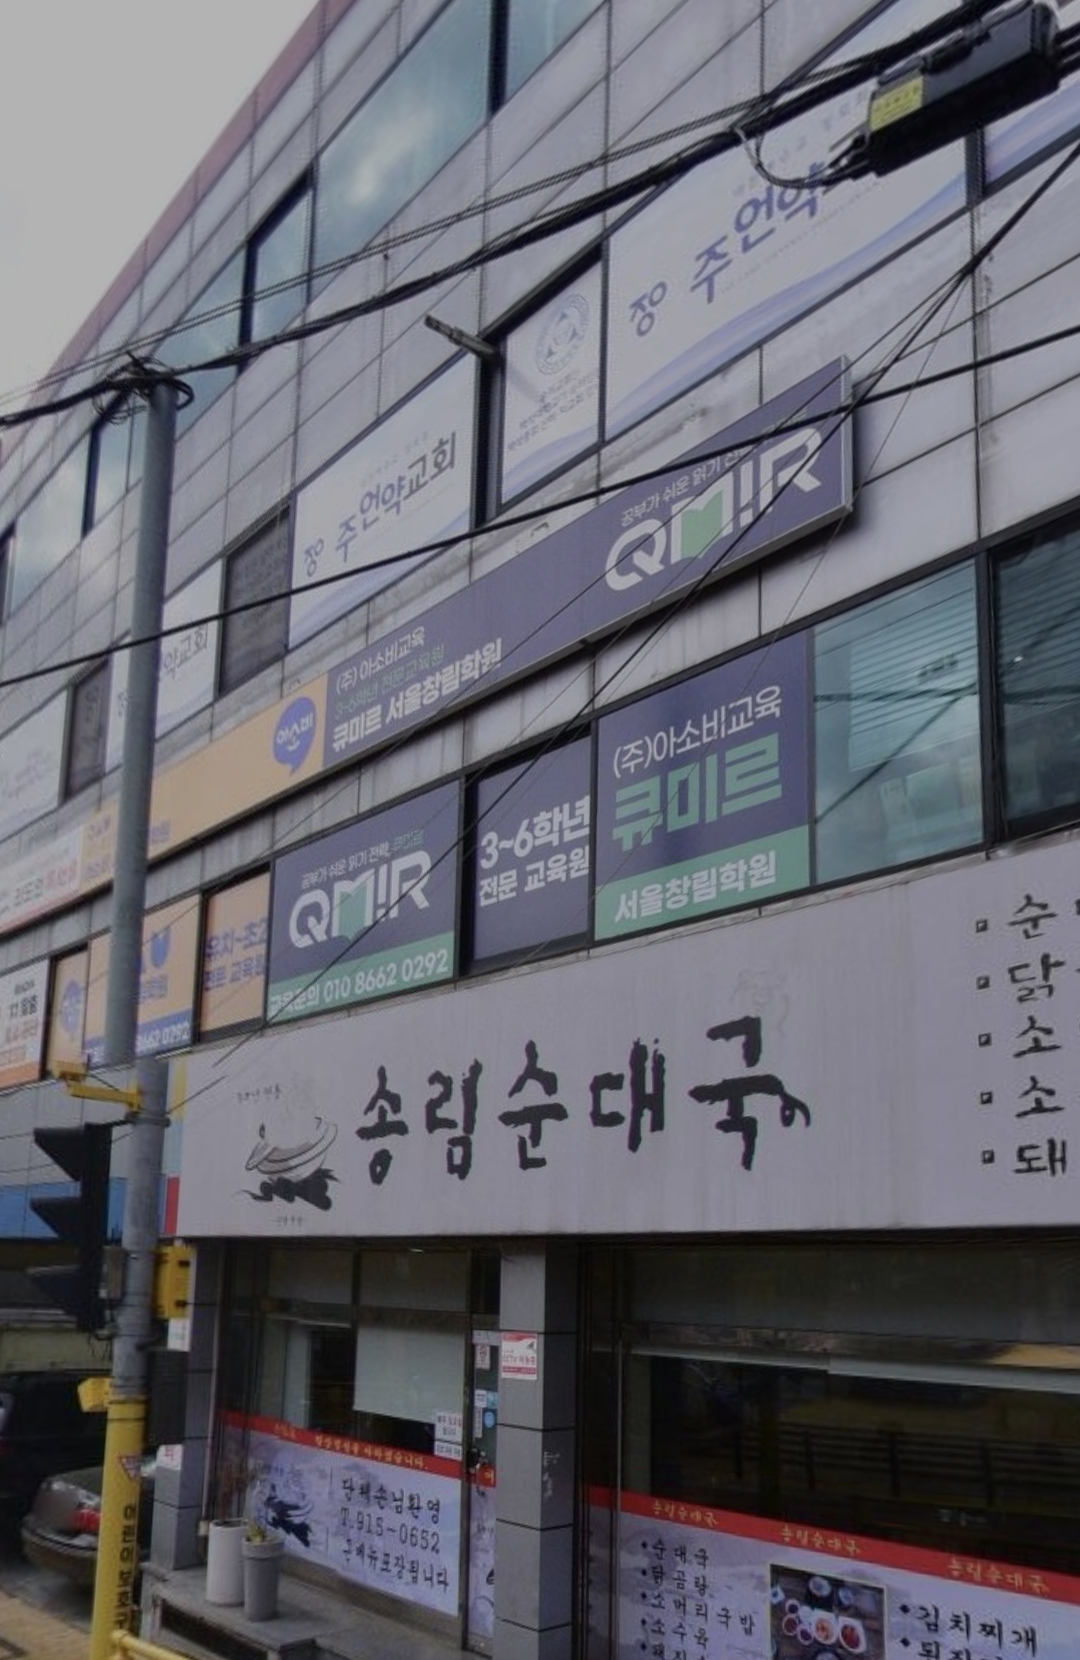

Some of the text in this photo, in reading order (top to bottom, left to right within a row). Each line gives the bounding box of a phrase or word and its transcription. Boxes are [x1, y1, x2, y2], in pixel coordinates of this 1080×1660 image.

[332, 637, 502, 752] 큐미르 서울창림학원
[613, 684, 782, 778] (주)아소비교육
[611, 731, 783, 853] 큐미르
[479, 794, 591, 869] 3~6학년
[478, 844, 591, 908] 전문 교육원
[614, 850, 777, 923] 서울창림학원
[323, 976, 351, 1001] 010
[354, 963, 398, 995] 8662
[400, 949, 449, 982] 0292
[355, 1014, 811, 1185] 송림순대국
[917, 1603, 1038, 1657] 김치찌개
